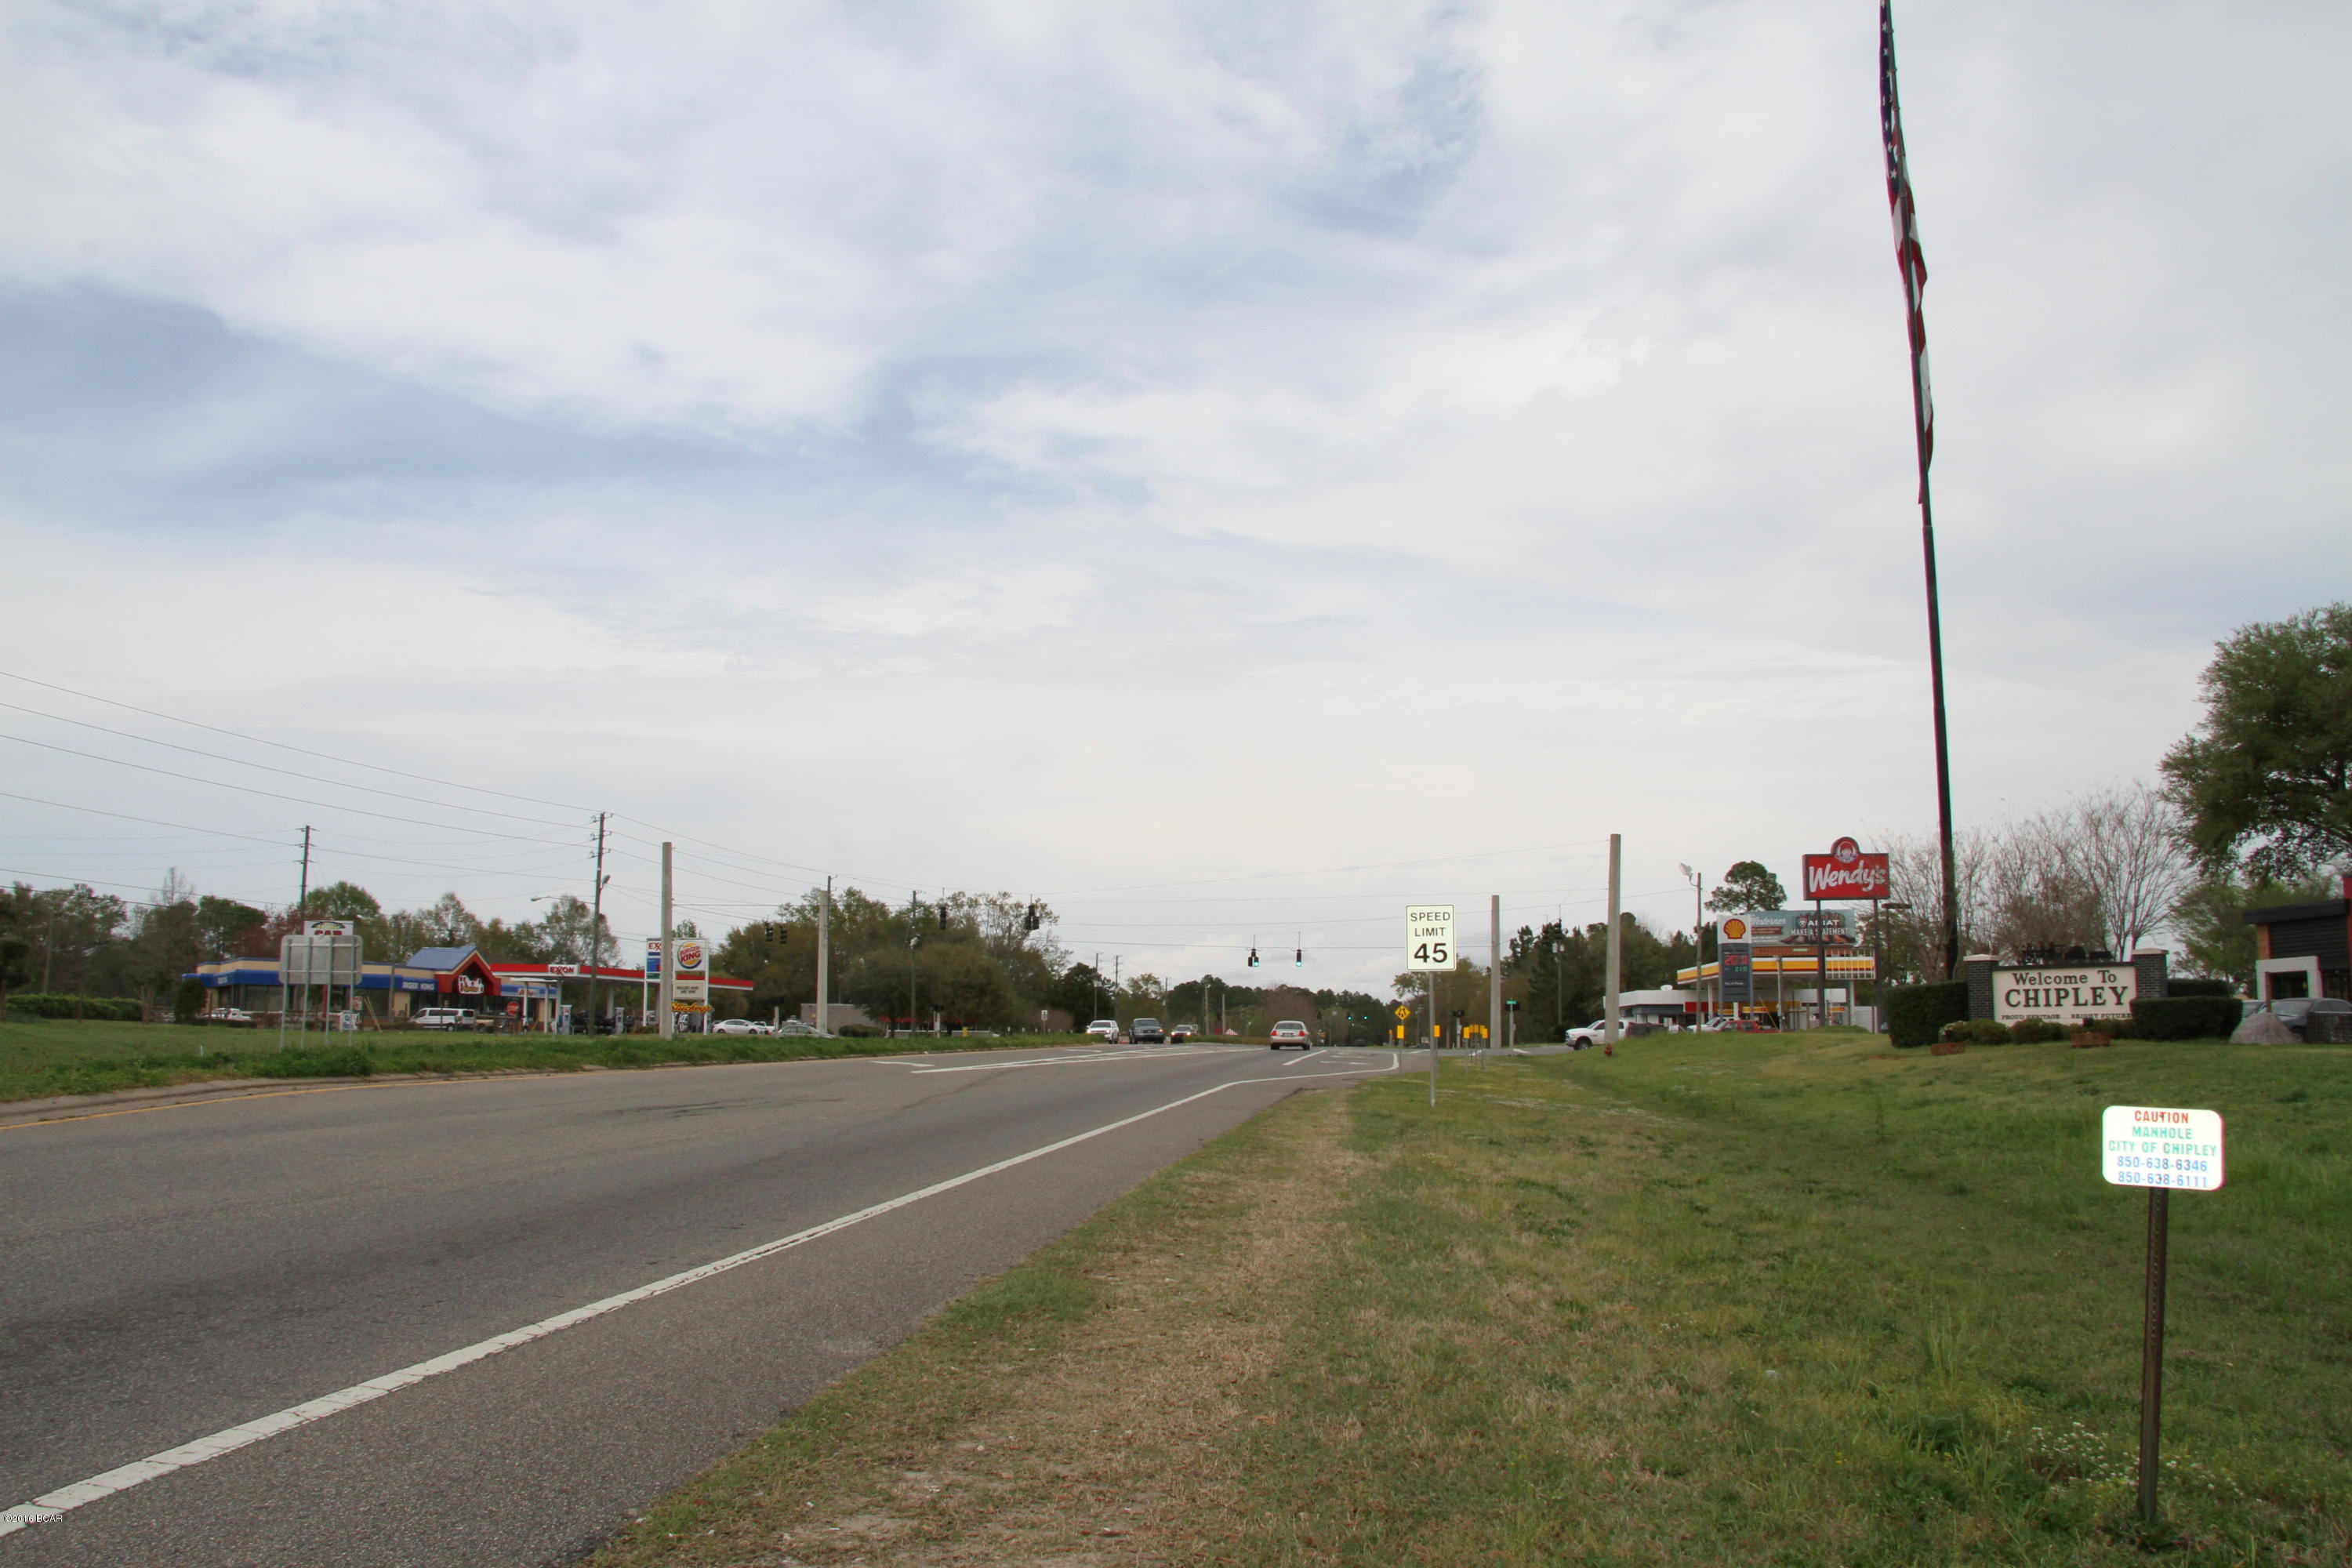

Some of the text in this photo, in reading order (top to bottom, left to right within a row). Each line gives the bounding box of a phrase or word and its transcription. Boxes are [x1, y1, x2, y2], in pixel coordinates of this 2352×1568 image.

[1809, 860, 1886, 892] Wendy's
[1410, 912, 1450, 922] SPEED
[1414, 927, 1446, 937] LIMIT
[680, 946, 700, 956] BURGER
[681, 950, 701, 963] KING
[1414, 942, 1448, 964] 45
[550, 966, 574, 975] EXXON
[2013, 970, 2117, 985] Welcome To
[2005, 986, 2128, 1007] CHIPLEY
[2134, 1110, 2189, 1123] CAUTION
[2132, 1126, 2192, 1139] MANHOLE
[2108, 1140, 2216, 1156] CITY OF CHIPLEY
[2117, 1156, 2208, 1171] 850-638-6346
[2118, 1171, 2208, 1187] 850-638-6111
